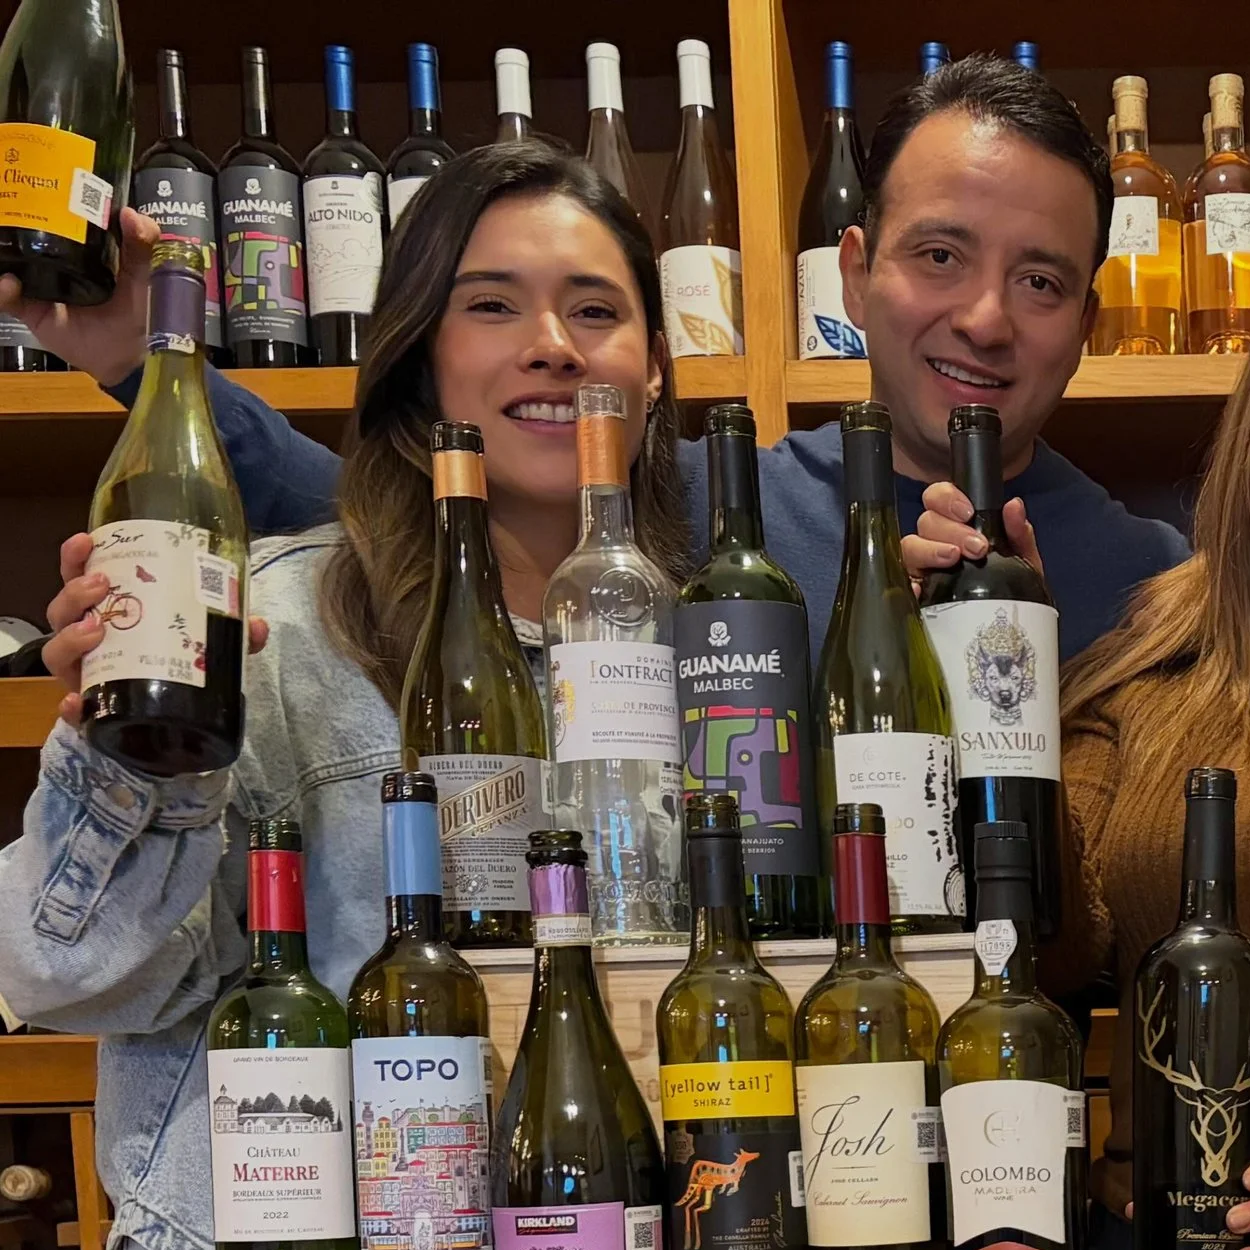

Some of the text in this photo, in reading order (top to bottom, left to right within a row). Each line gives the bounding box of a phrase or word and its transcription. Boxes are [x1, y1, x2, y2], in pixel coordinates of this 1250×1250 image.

[223, 199, 294, 218] GUANAMÉ
[308, 209, 374, 224] ALTO NIDO
[152, 215, 190, 226] ALBEC
[234, 214, 276, 225] MALBEC
[679, 648, 782, 680] GUANAMÉ
[693, 677, 754, 694] MALBEC
[961, 731, 1046, 753] SANXULO
[849, 772, 864, 783] DE
[441, 770, 525, 836] DERIVERO
[468, 865, 485, 873] DEL
[487, 863, 517, 873] DUERO
[374, 1058, 460, 1082] TOPO
[693, 1098, 732, 1107] SHIRAZ
[246, 1145, 301, 1159] CHÂTEAU
[804, 1095, 895, 1195] Josh
[232, 1163, 320, 1183] MATERRE
[960, 1166, 1051, 1185] COLOMBO
[232, 1190, 274, 1198] BORDEAUX
[851, 1190, 908, 1208] Sauvignon
[1167, 1191, 1248, 1213] Megace
[263, 1211, 289, 1220] 2022
[517, 1216, 576, 1228] KIRKLAND
